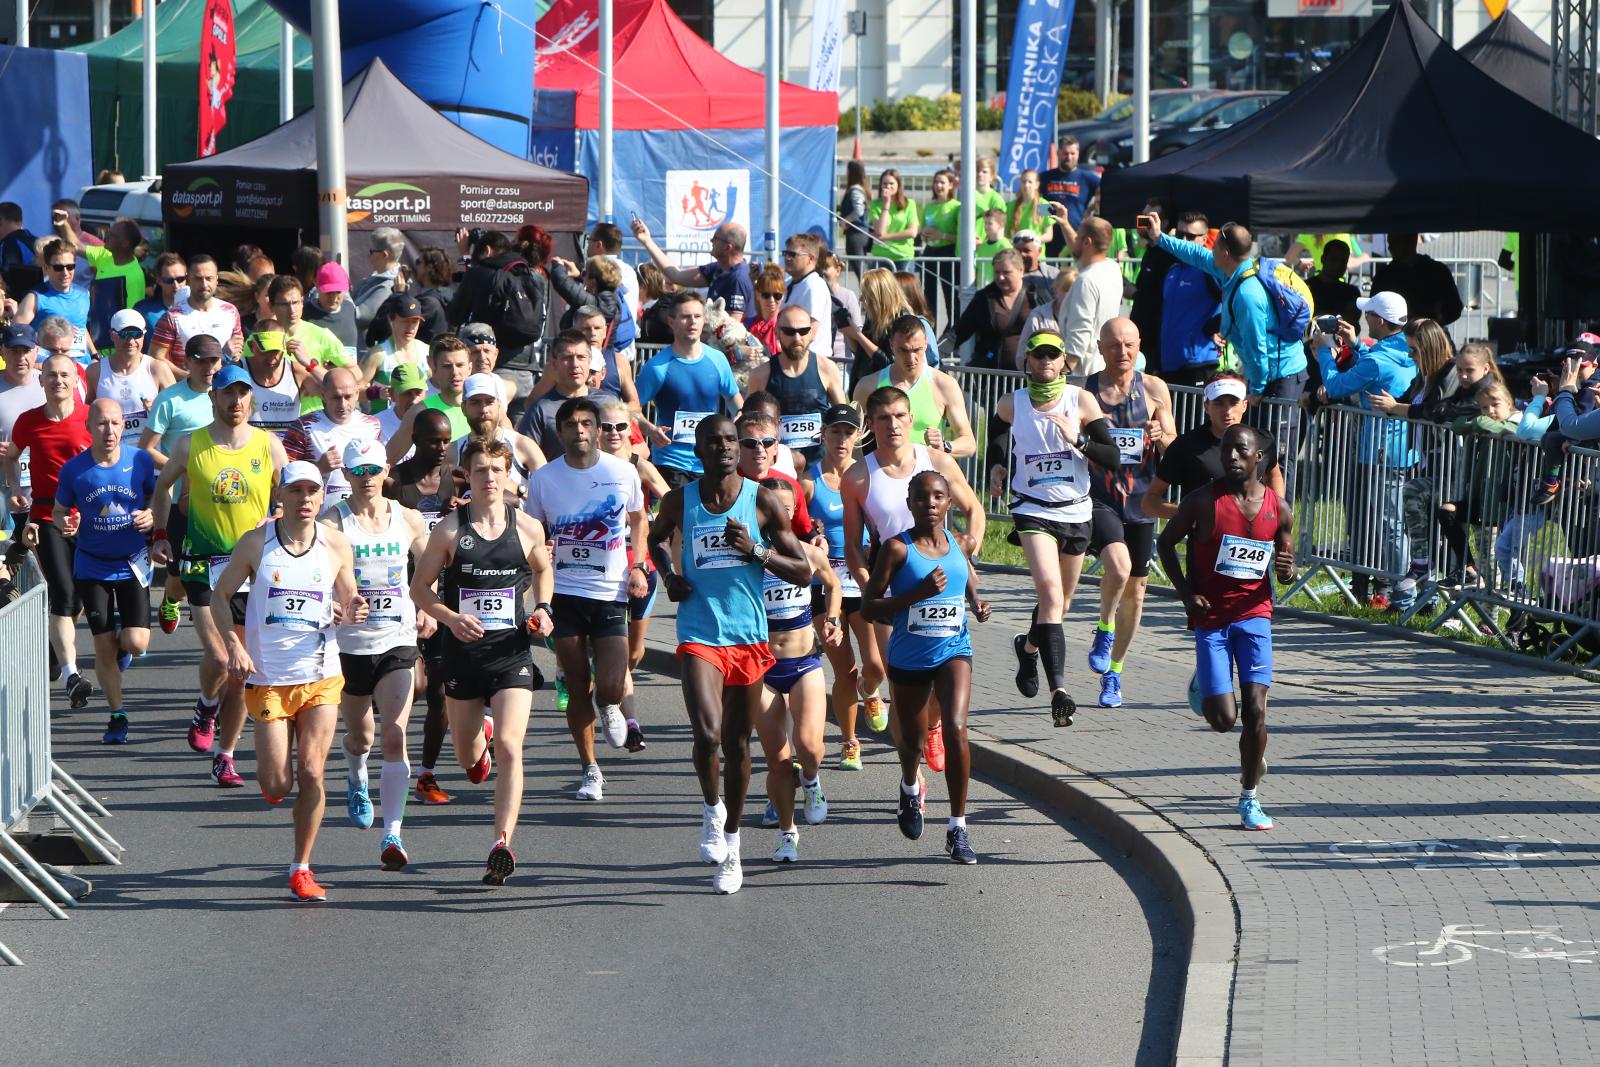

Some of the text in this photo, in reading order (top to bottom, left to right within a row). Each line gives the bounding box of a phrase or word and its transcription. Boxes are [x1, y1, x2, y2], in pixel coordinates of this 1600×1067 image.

[1009, 21, 1042, 174] POLITECHNIKA
[1024, 23, 1067, 172] OPOLSKA
[460, 184, 520, 195] Pomiar czasu
[172, 190, 223, 206] datasport.pl
[346, 195, 431, 213] tasport.pl
[460, 199, 554, 212] sport@datasport.pl
[373, 214, 431, 223] SPORT TIMING
[460, 213, 524, 223] tel.602722968
[783, 421, 815, 433] 1258
[1035, 460, 1063, 473] 173
[86, 484, 137, 503] GRUPA BIEGOWA
[700, 535, 728, 549] 123
[571, 547, 590, 559] 63
[1228, 546, 1265, 561] 1248
[473, 568, 518, 576] Eurovent
[764, 585, 803, 602] 1272
[285, 598, 306, 611] 37
[473, 599, 503, 611] 153
[918, 606, 957, 619] 1234
